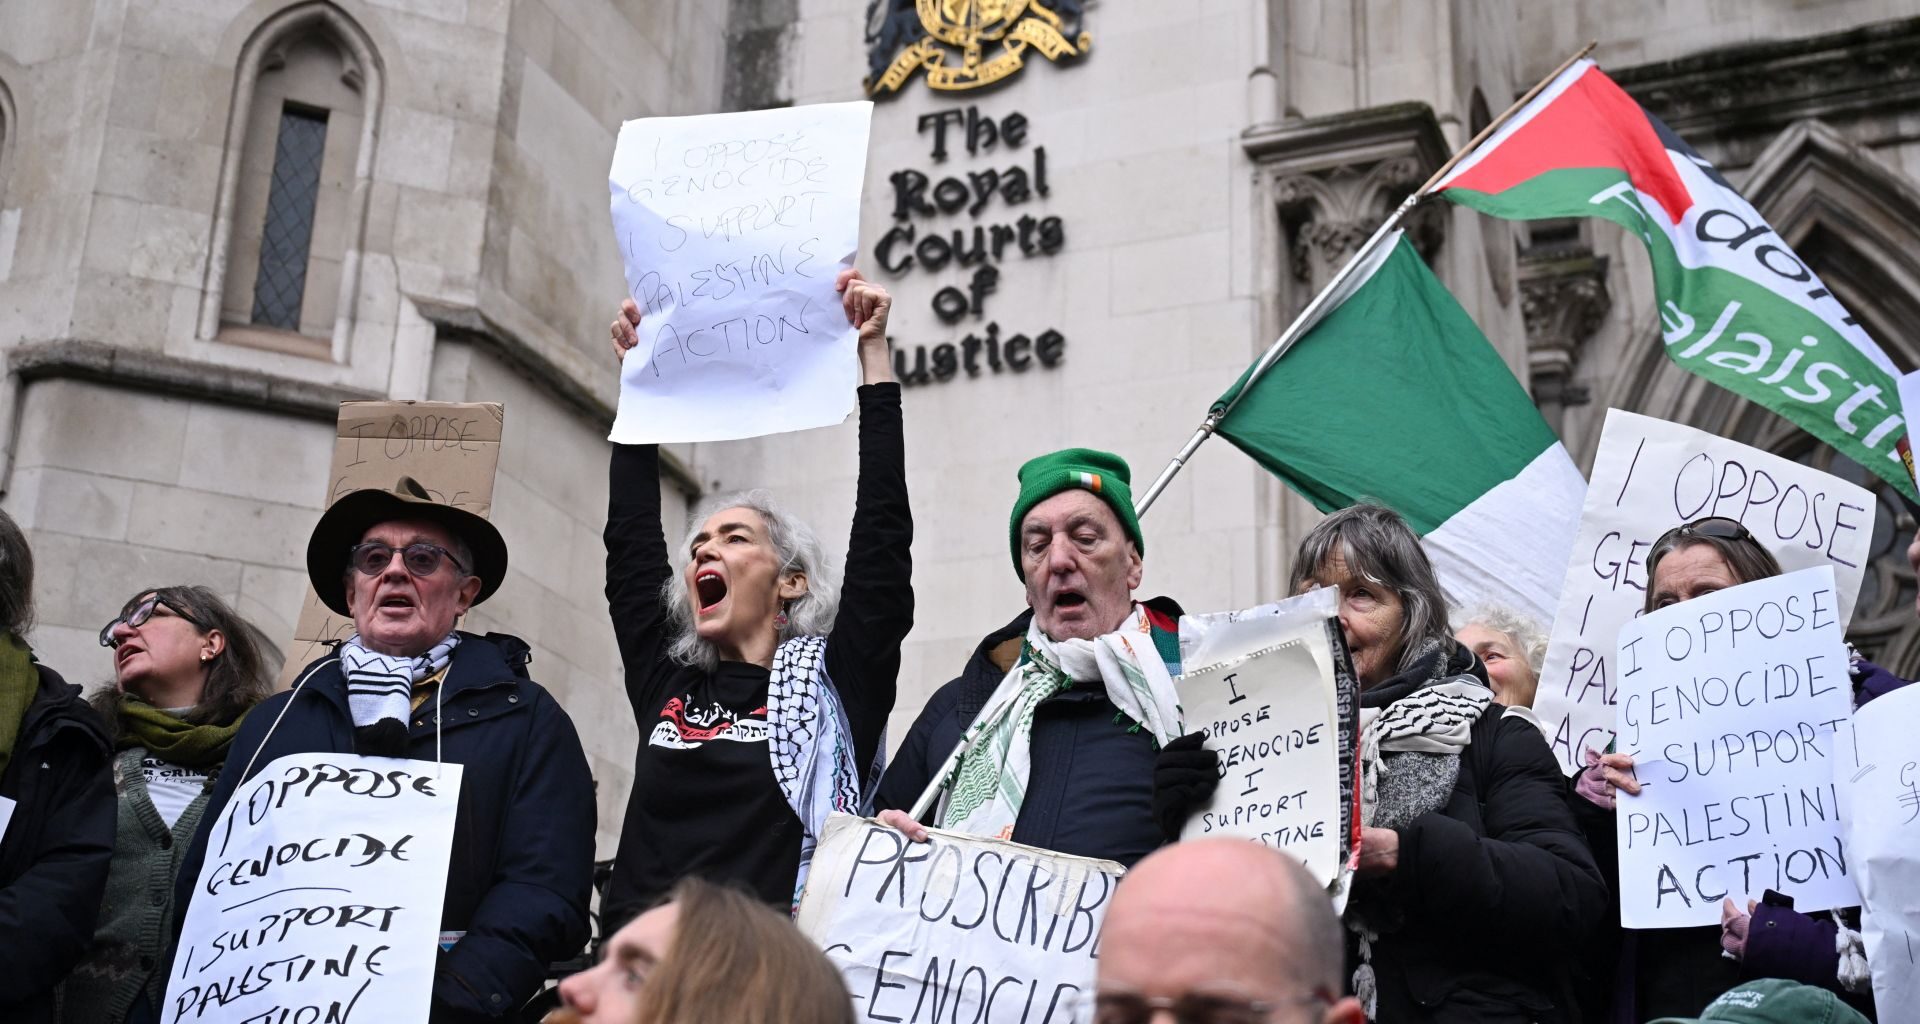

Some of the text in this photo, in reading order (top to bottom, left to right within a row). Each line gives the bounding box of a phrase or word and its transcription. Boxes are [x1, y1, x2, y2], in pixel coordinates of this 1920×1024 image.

[683, 131, 809, 169] OPPOSE
[916, 105, 1028, 164] The
[627, 156, 829, 205] GENOCIDE
[890, 145, 1049, 222] Royal
[658, 191, 830, 252] SUPPORT
[873, 213, 1065, 275] Courts
[634, 237, 820, 318] PALESTINE
[930, 263, 999, 326] of
[651, 304, 810, 378] ACTION
[887, 321, 1067, 388] ustice
[345, 421, 375, 468] I
[1616, 437, 1646, 507] I
[1674, 453, 1865, 569] OPPOSE
[1621, 636, 1644, 678] I
[1665, 589, 1835, 662] OPPOSE
[1222, 673, 1247, 705] I
[1217, 723, 1325, 780] GENOCIDE
[1240, 767, 1264, 796] I
[1664, 717, 1848, 784] SUPPORT
[248, 763, 438, 826] OPPOSE
[206, 833, 415, 896] GENOCIDE
[845, 828, 1115, 959] PROSCRIB
[199, 905, 406, 973] SUPPORT
[174, 944, 391, 1024] PALESTINE
